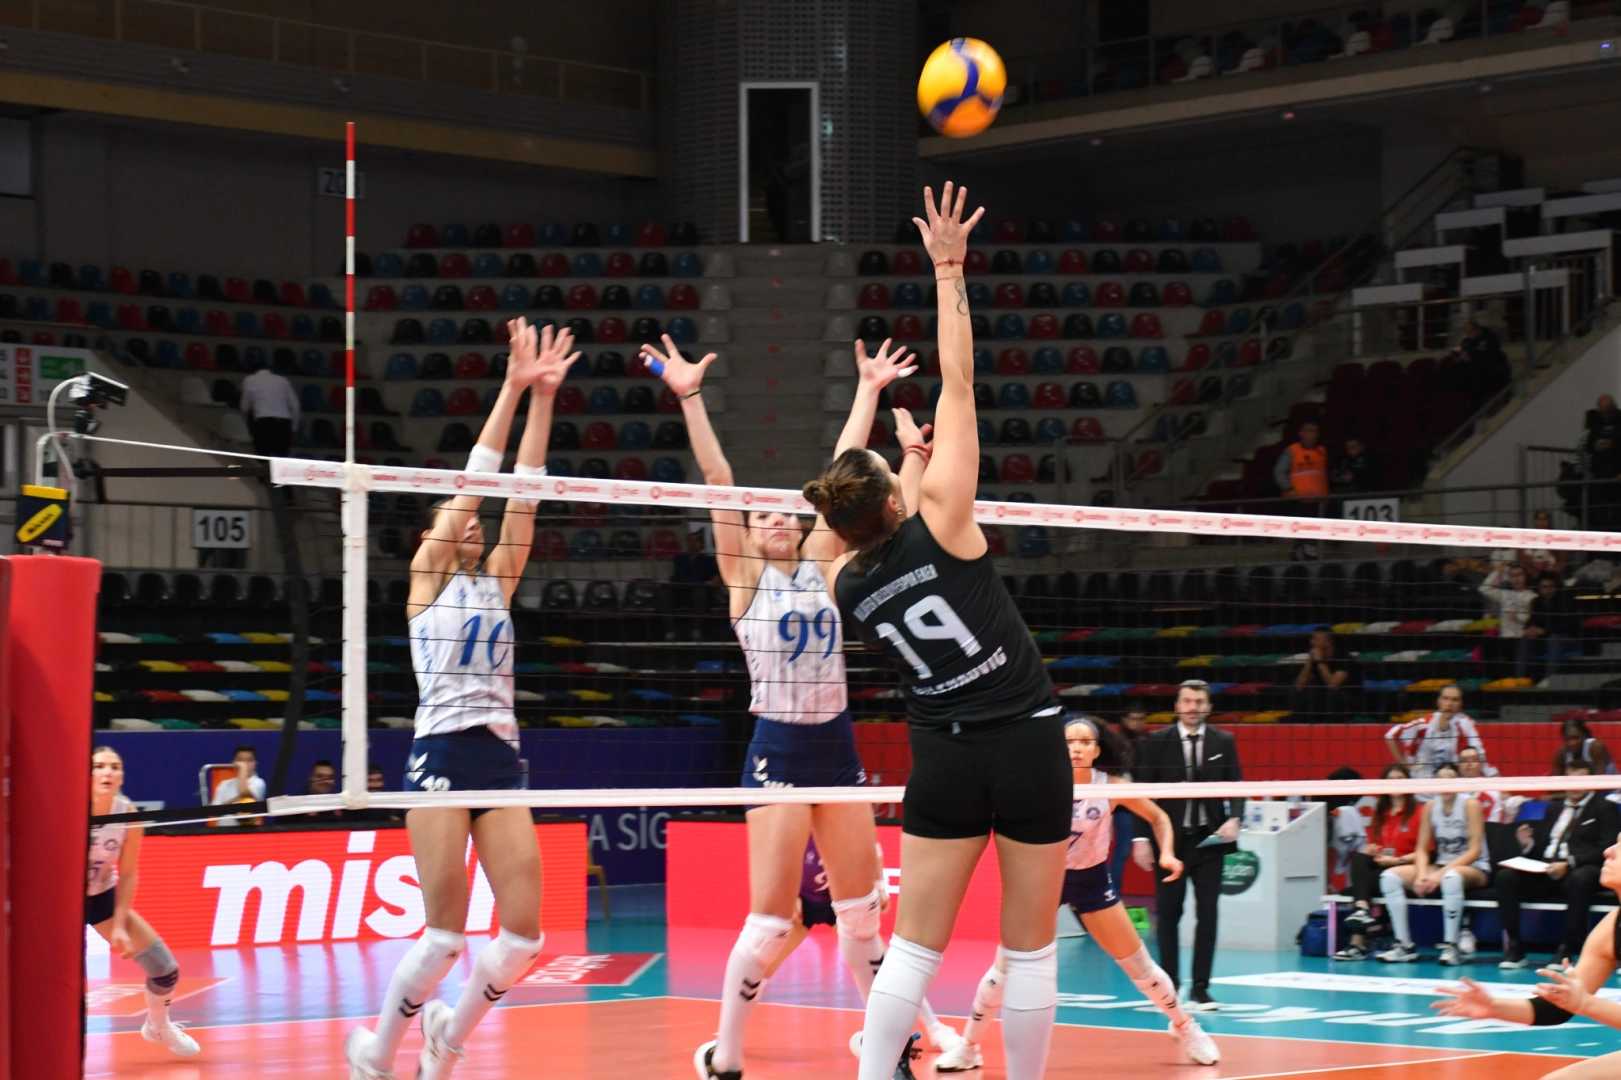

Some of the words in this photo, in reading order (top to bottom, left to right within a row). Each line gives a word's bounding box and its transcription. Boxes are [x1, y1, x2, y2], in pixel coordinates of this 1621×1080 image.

[323, 170, 361, 196] 20
[198, 516, 246, 542] 105
[458, 614, 510, 670] 10
[778, 607, 837, 664] 99
[874, 594, 983, 680] 19
[202, 831, 497, 946] mis
